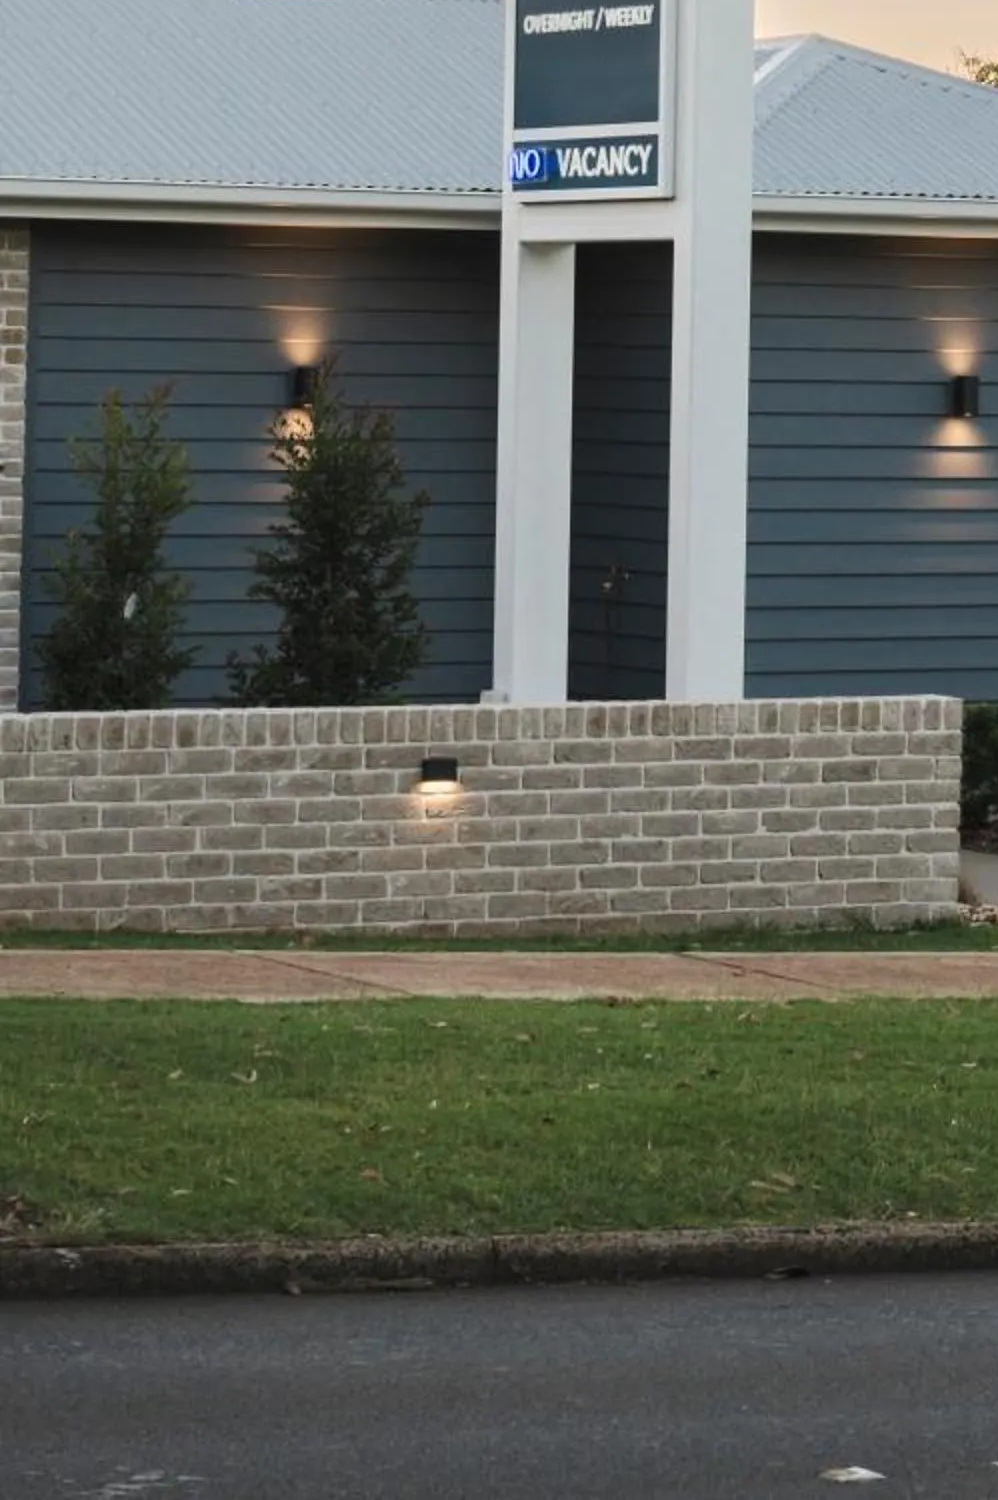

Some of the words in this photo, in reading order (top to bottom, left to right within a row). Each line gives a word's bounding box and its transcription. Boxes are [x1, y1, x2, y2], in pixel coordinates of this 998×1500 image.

[523, 8, 595, 34] OVERNIGHT
[604, 4, 654, 28] WEEKLY
[510, 150, 541, 179] NO
[556, 143, 652, 178] VACANCY
